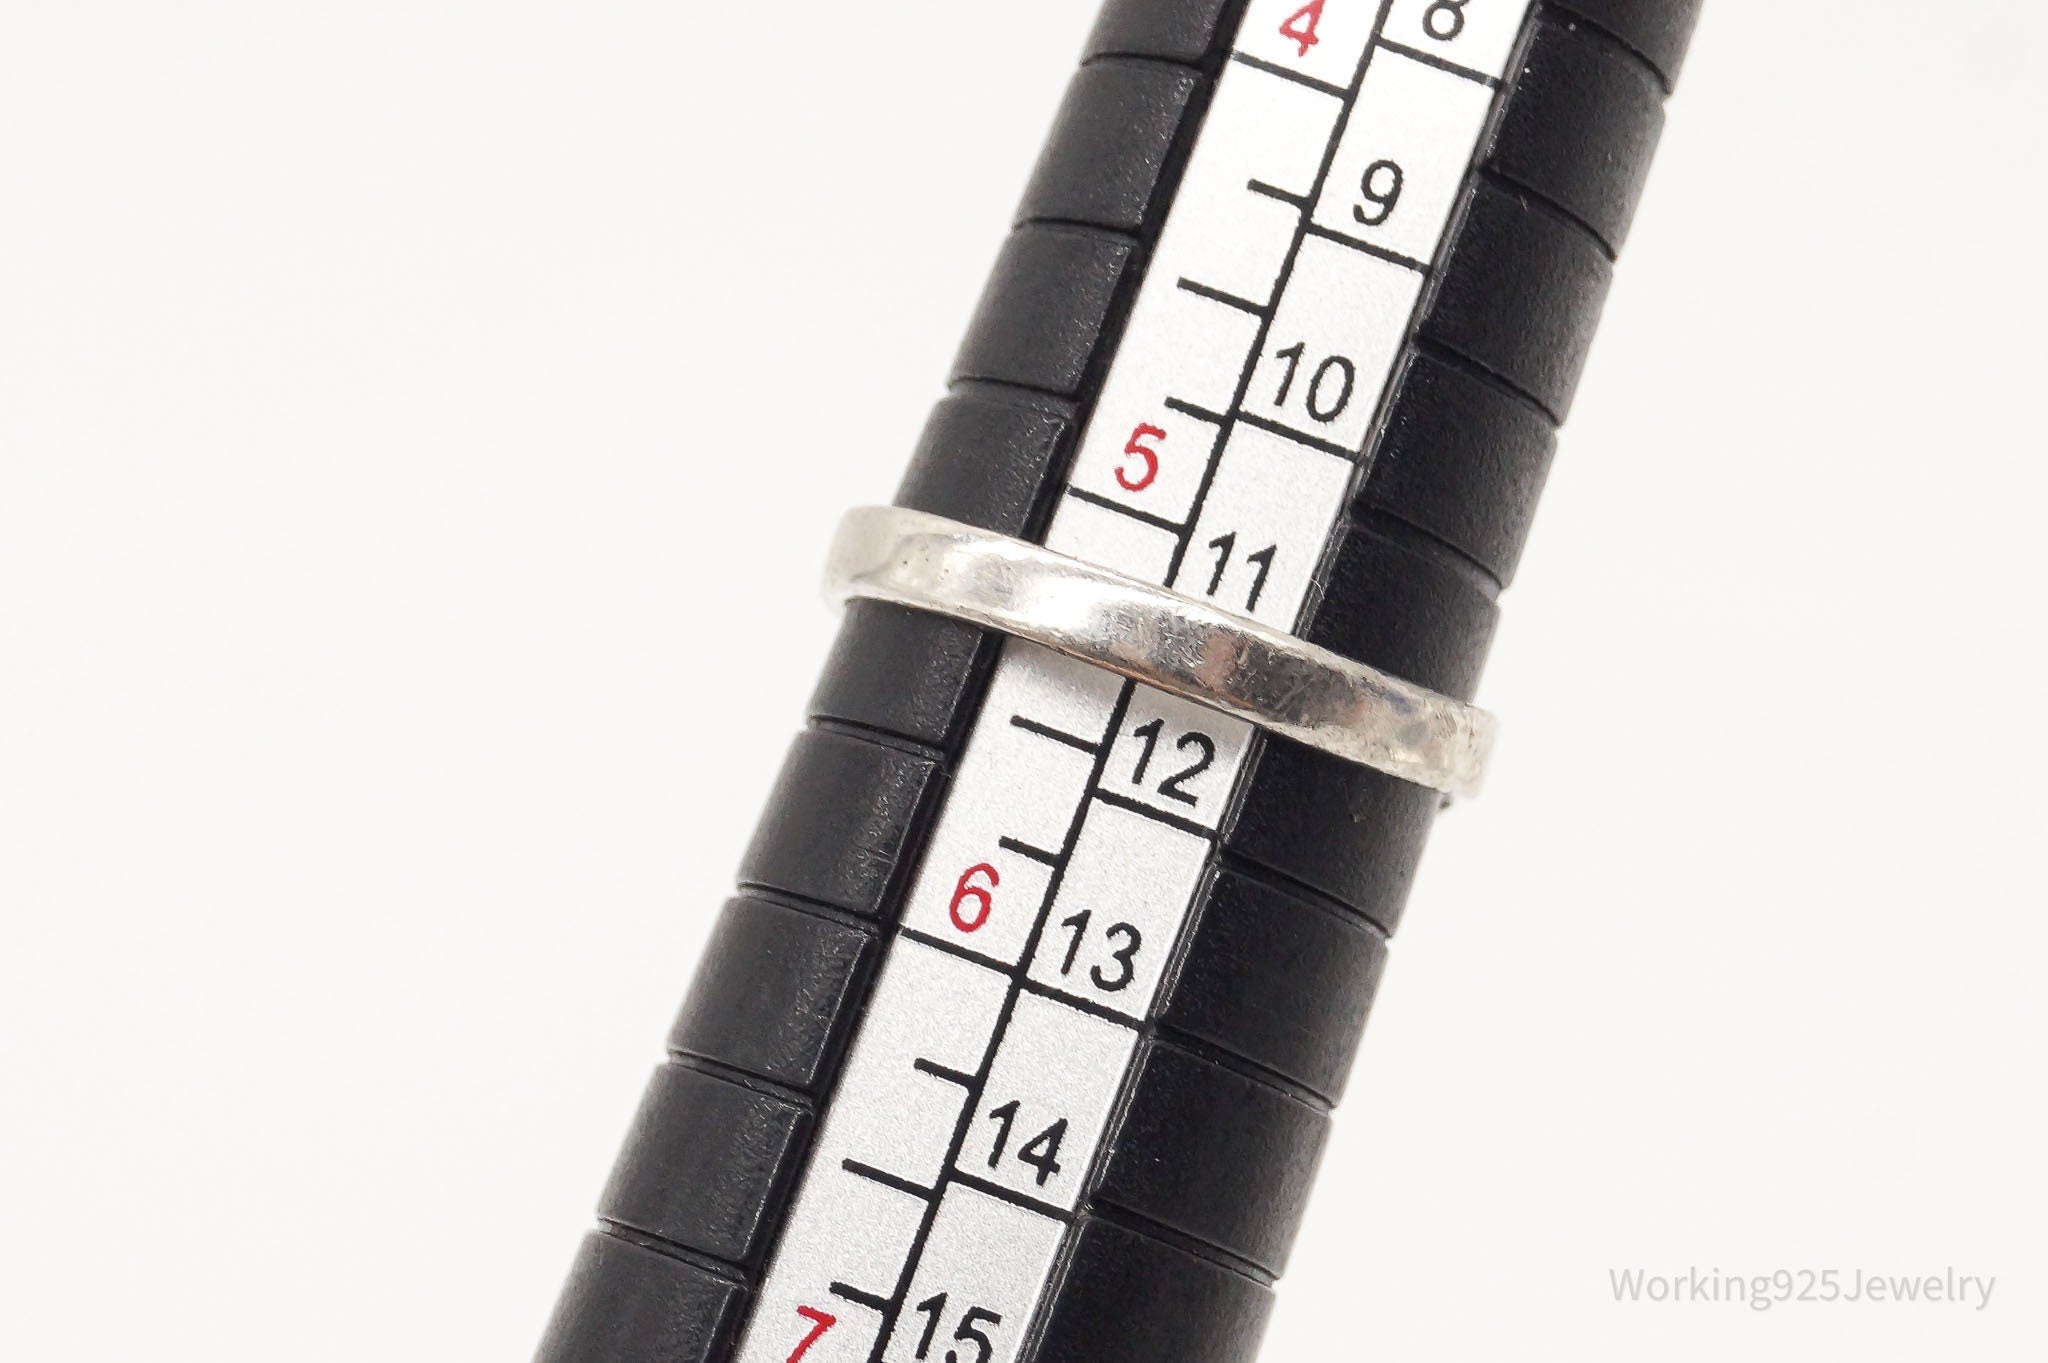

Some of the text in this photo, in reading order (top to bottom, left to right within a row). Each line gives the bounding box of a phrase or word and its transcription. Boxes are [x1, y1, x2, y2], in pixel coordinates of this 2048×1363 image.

[1280, 0, 1324, 56] 4
[1354, 160, 1403, 226] 9
[1274, 342, 1355, 424] 10
[1115, 423, 1166, 491] 5
[1207, 532, 1277, 612] 11
[1132, 718, 1216, 808] 12
[950, 863, 999, 933] 6
[1061, 910, 1141, 992] 13
[988, 1101, 1068, 1187] 14
[786, 1306, 836, 1363] 7
[915, 1292, 1002, 1363] 15
